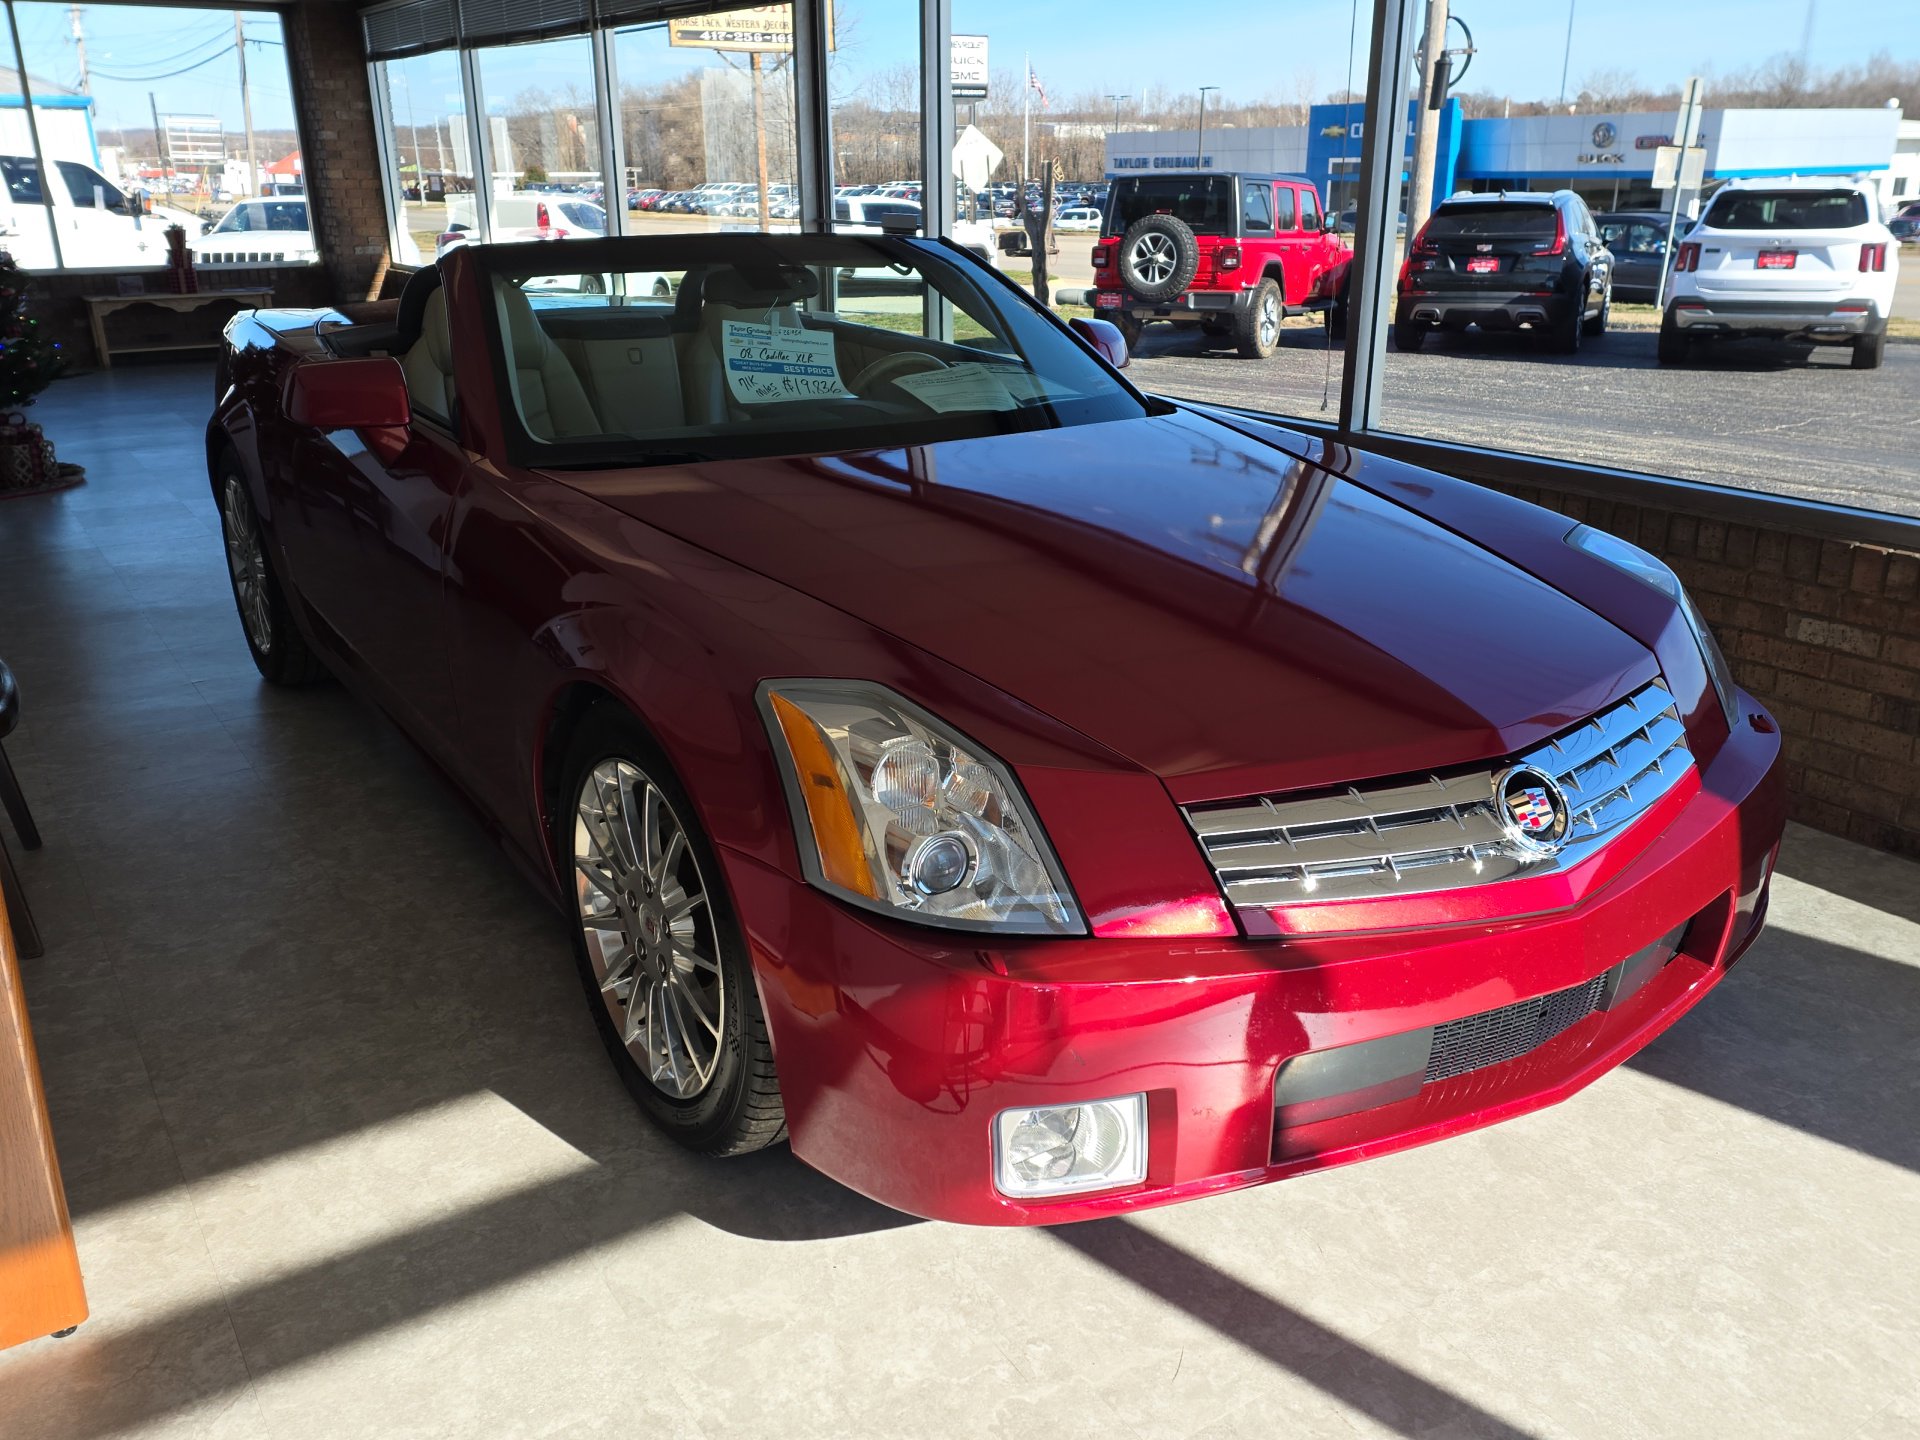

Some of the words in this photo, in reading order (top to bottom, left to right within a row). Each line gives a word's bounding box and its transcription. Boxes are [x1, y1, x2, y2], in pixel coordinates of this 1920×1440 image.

[725, 19, 760, 29] WESTERN
[763, 20, 790, 31] DECOR
[699, 31, 793, 43] 417-256-16
[951, 56, 984, 65] UICK
[951, 72, 980, 80] GMC
[1113, 157, 1150, 168] TAYLOR
[1577, 153, 1624, 164] BUICK
[740, 347, 753, 359] 08
[760, 347, 790, 361] Cadillac
[796, 353, 814, 363] XLR
[783, 365, 805, 373] BEST
[807, 367, 833, 375] PRICE
